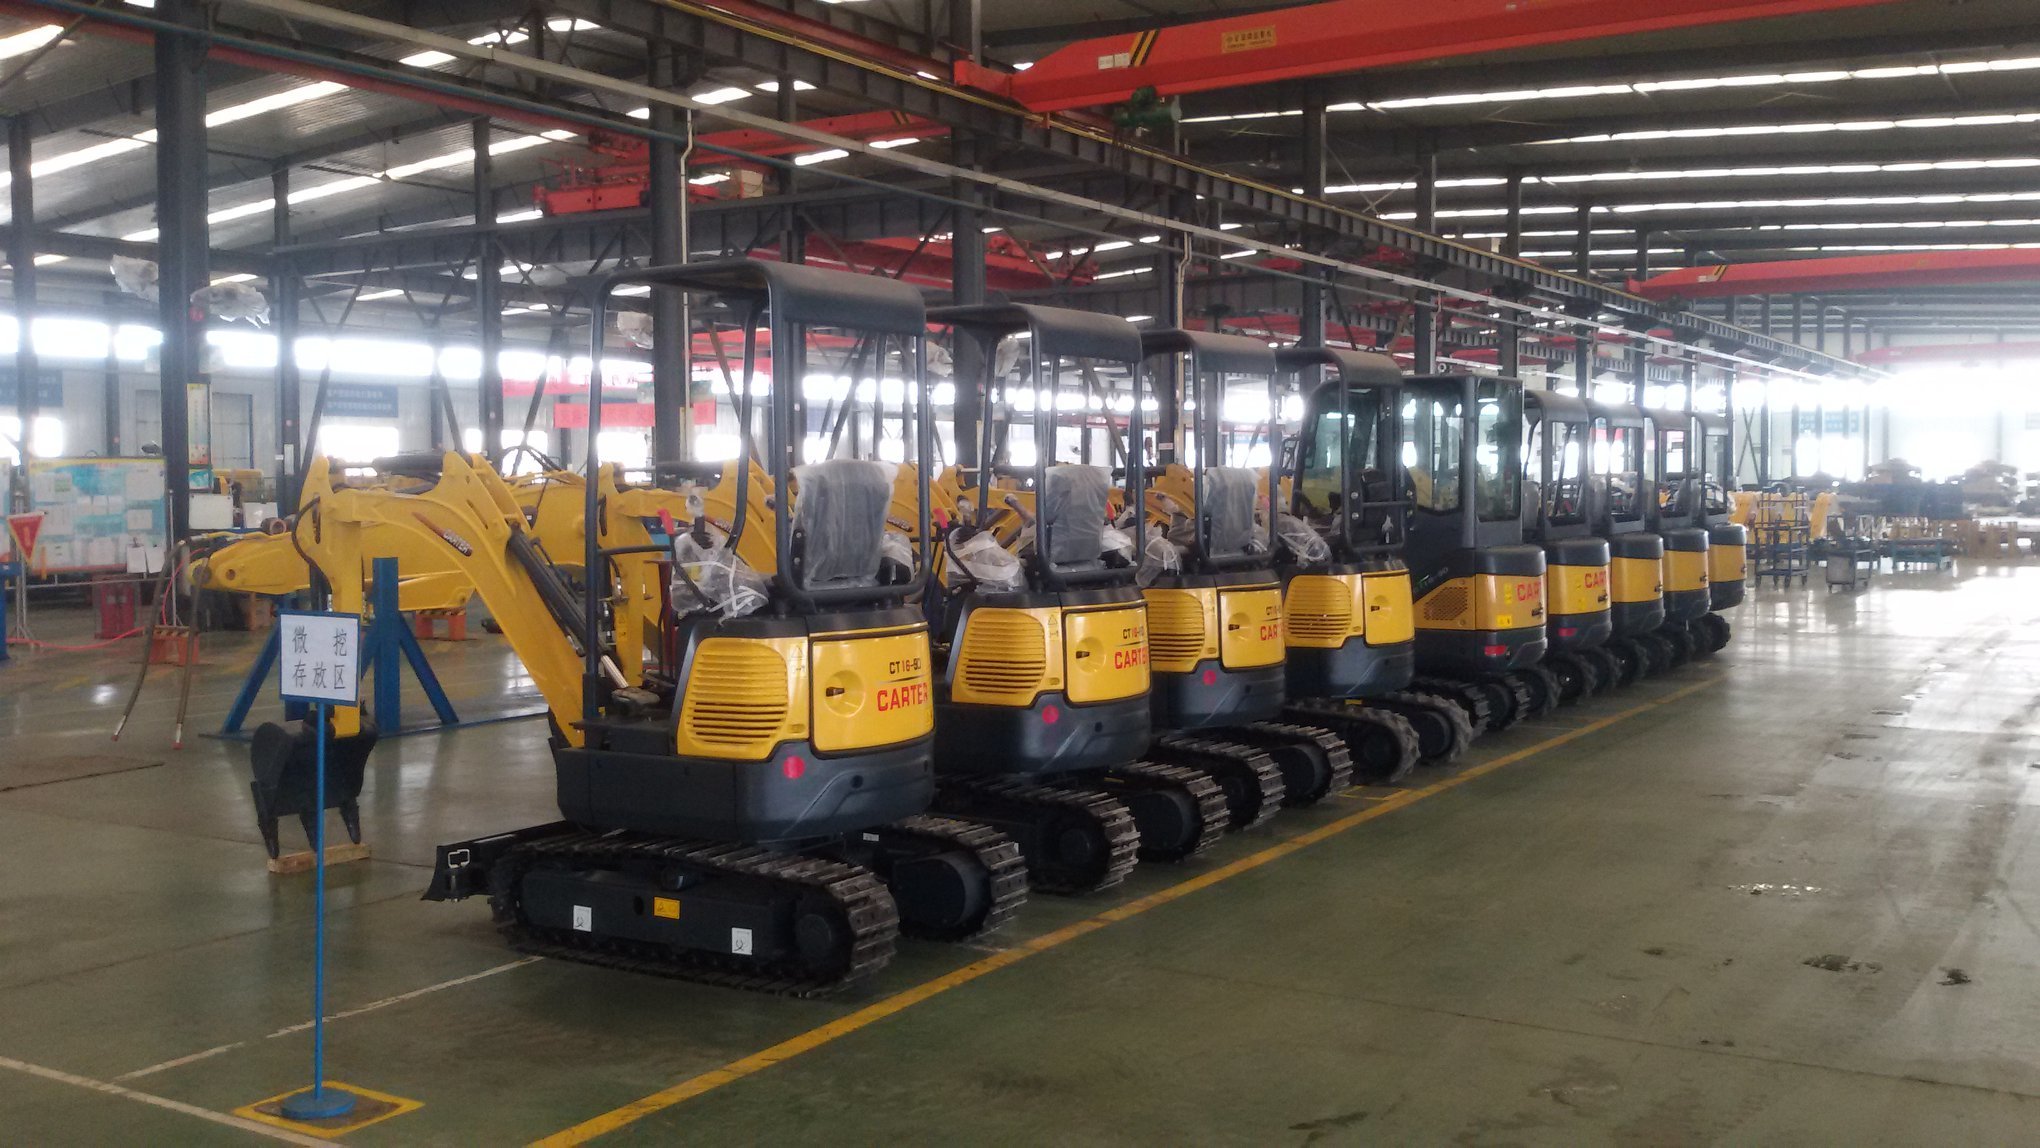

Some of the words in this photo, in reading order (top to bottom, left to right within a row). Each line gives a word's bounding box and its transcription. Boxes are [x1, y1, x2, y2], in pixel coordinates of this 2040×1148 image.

[292, 659, 347, 690] 存放区
[877, 682, 928, 712] CARTER
